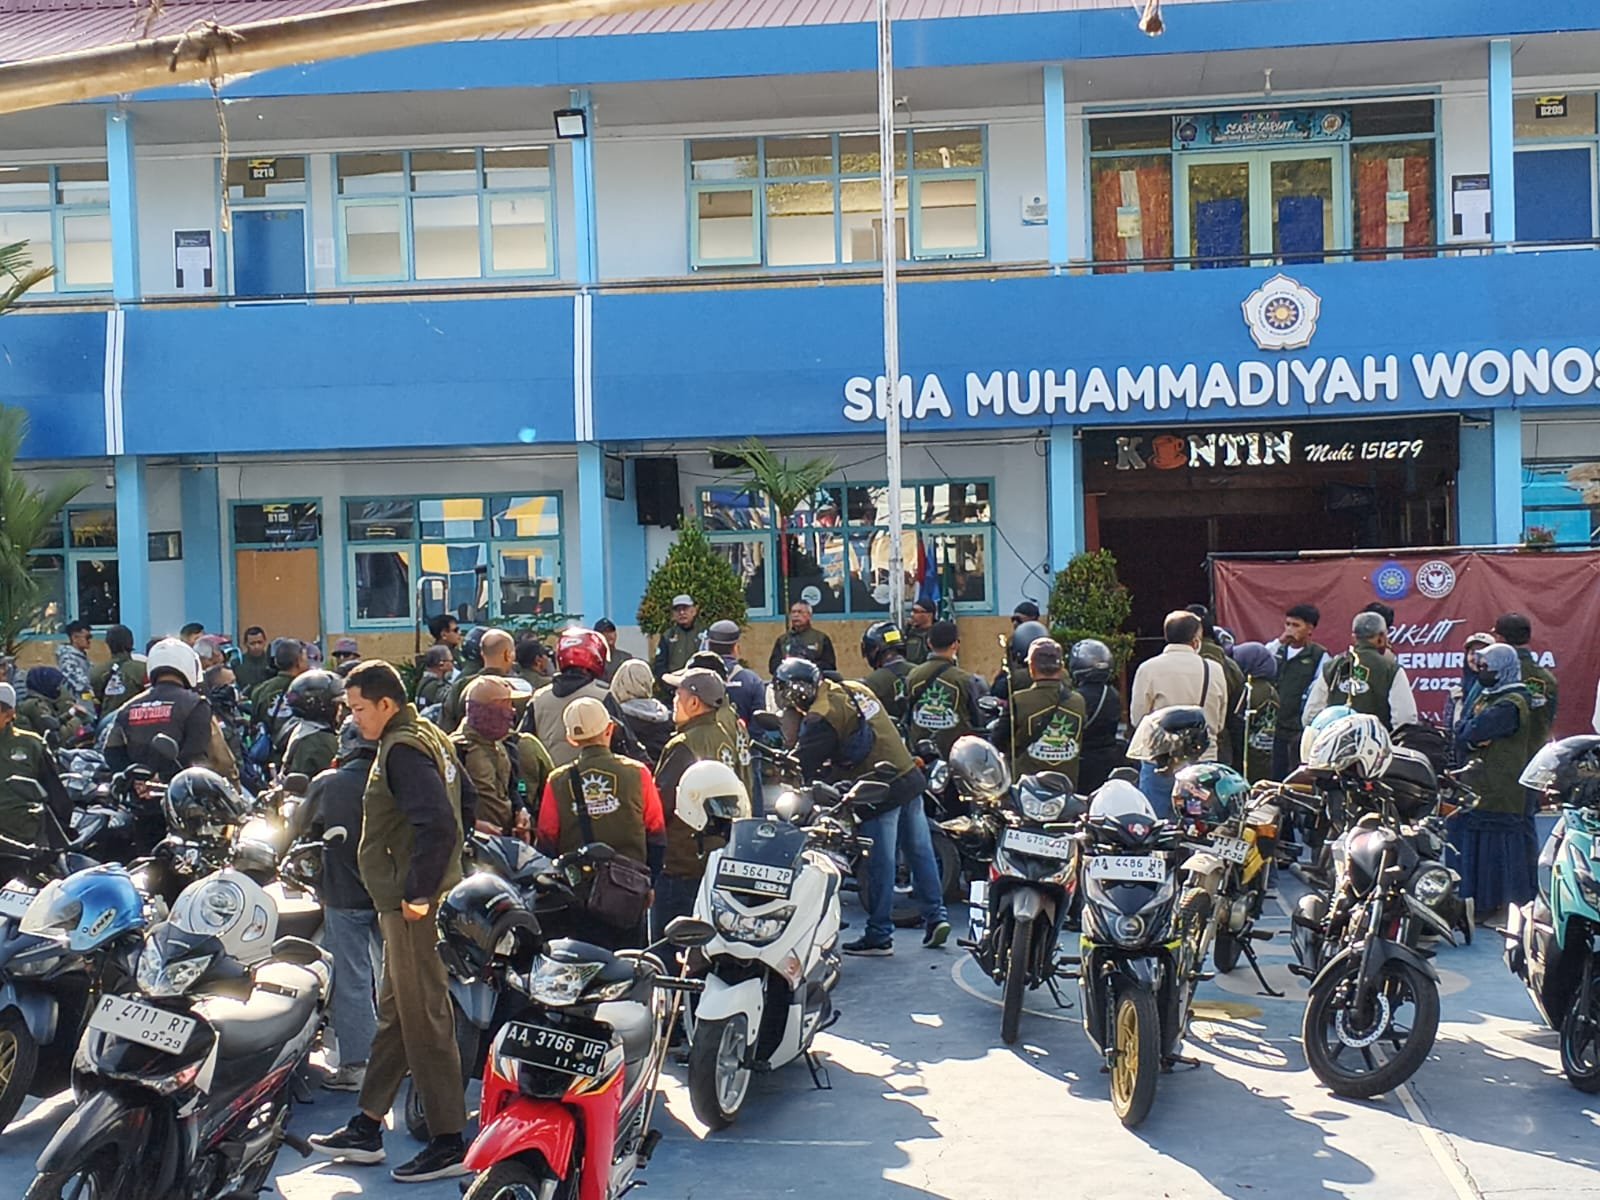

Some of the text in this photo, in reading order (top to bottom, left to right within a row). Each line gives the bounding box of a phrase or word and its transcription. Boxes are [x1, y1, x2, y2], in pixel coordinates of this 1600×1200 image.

[843, 346, 1600, 422] SMA MUHAMMADIYAH WONO
[1361, 439, 1424, 459] 151279
[1395, 652, 1465, 669] ERWIR
[722, 862, 791, 881] AA 5641 ZP
[1115, 859, 1143, 868] 4486
[1, 892, 17, 901] AA
[101, 998, 190, 1034] R 4711 RT
[507, 1025, 604, 1059] AA 3766 UF
